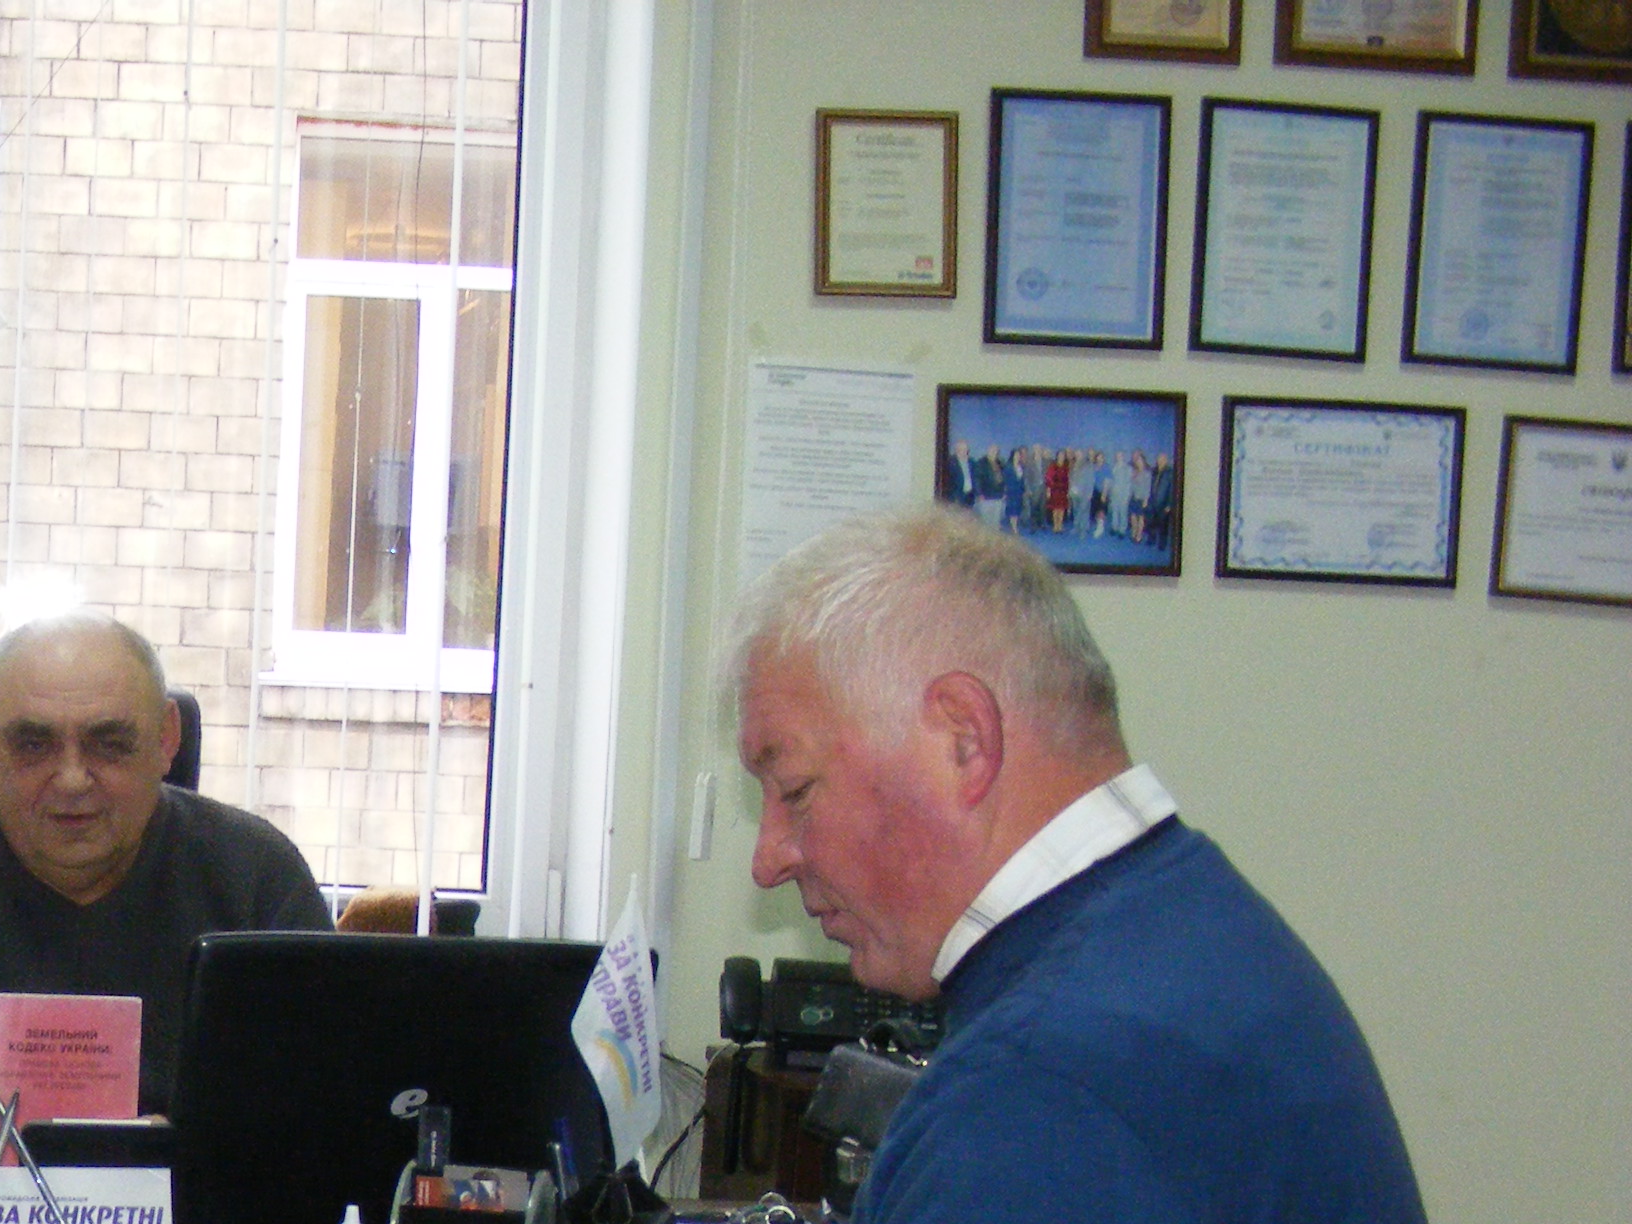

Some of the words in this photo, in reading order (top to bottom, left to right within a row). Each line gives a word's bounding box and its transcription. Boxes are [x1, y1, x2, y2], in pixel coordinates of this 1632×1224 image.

[591, 960, 632, 1042] ПРАВИ
[607, 939, 631, 971] ЗА
[622, 973, 652, 1093] КОНКРЕТНІ
